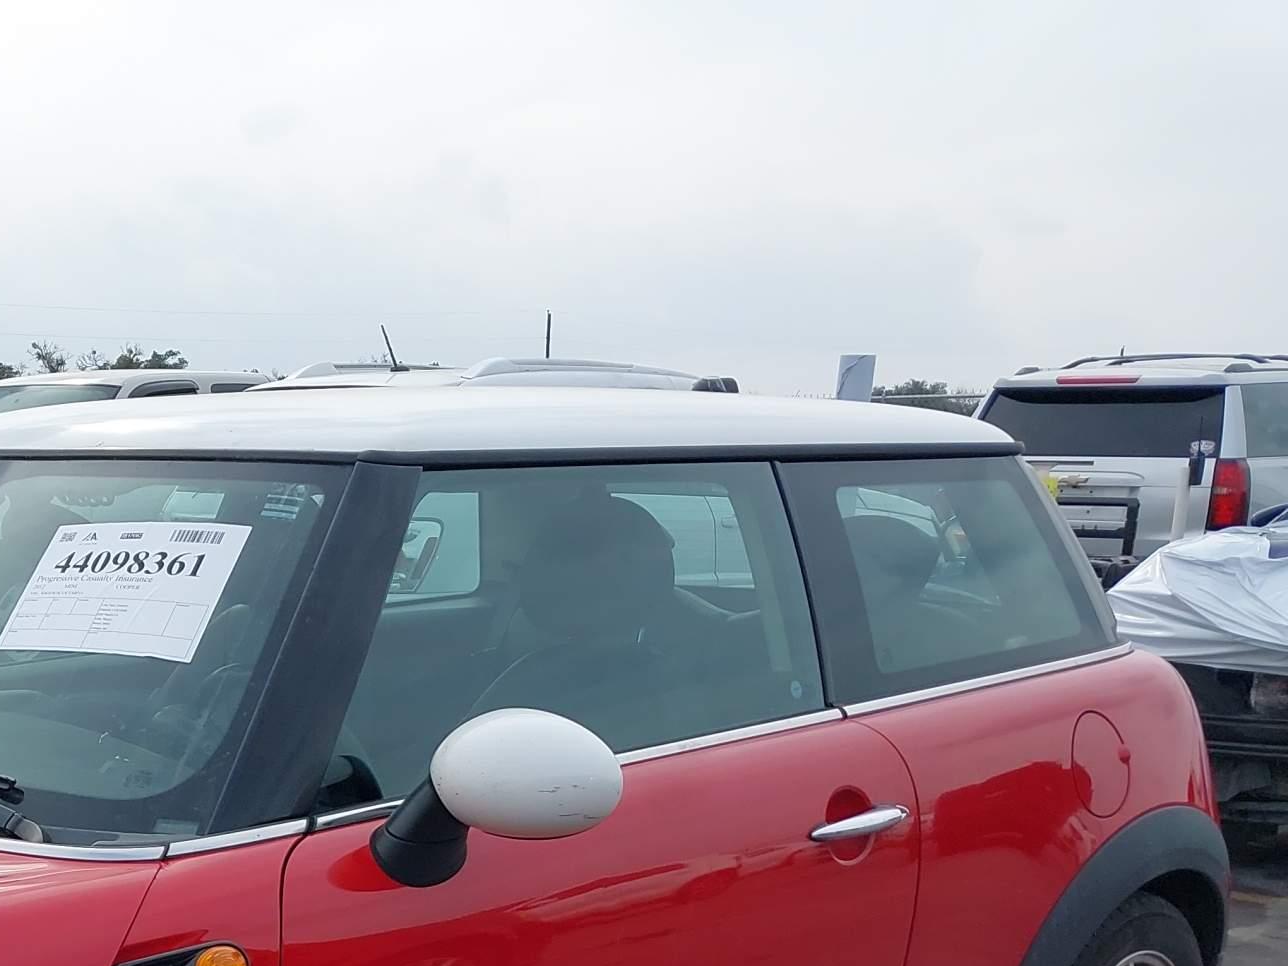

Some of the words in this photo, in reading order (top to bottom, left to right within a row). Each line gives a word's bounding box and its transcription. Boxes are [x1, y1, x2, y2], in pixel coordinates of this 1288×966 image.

[54, 551, 206, 578] 44098361
[36, 575, 79, 583] Progressive
[81, 574, 112, 583] Casualty
[115, 574, 153, 583] Insurance
